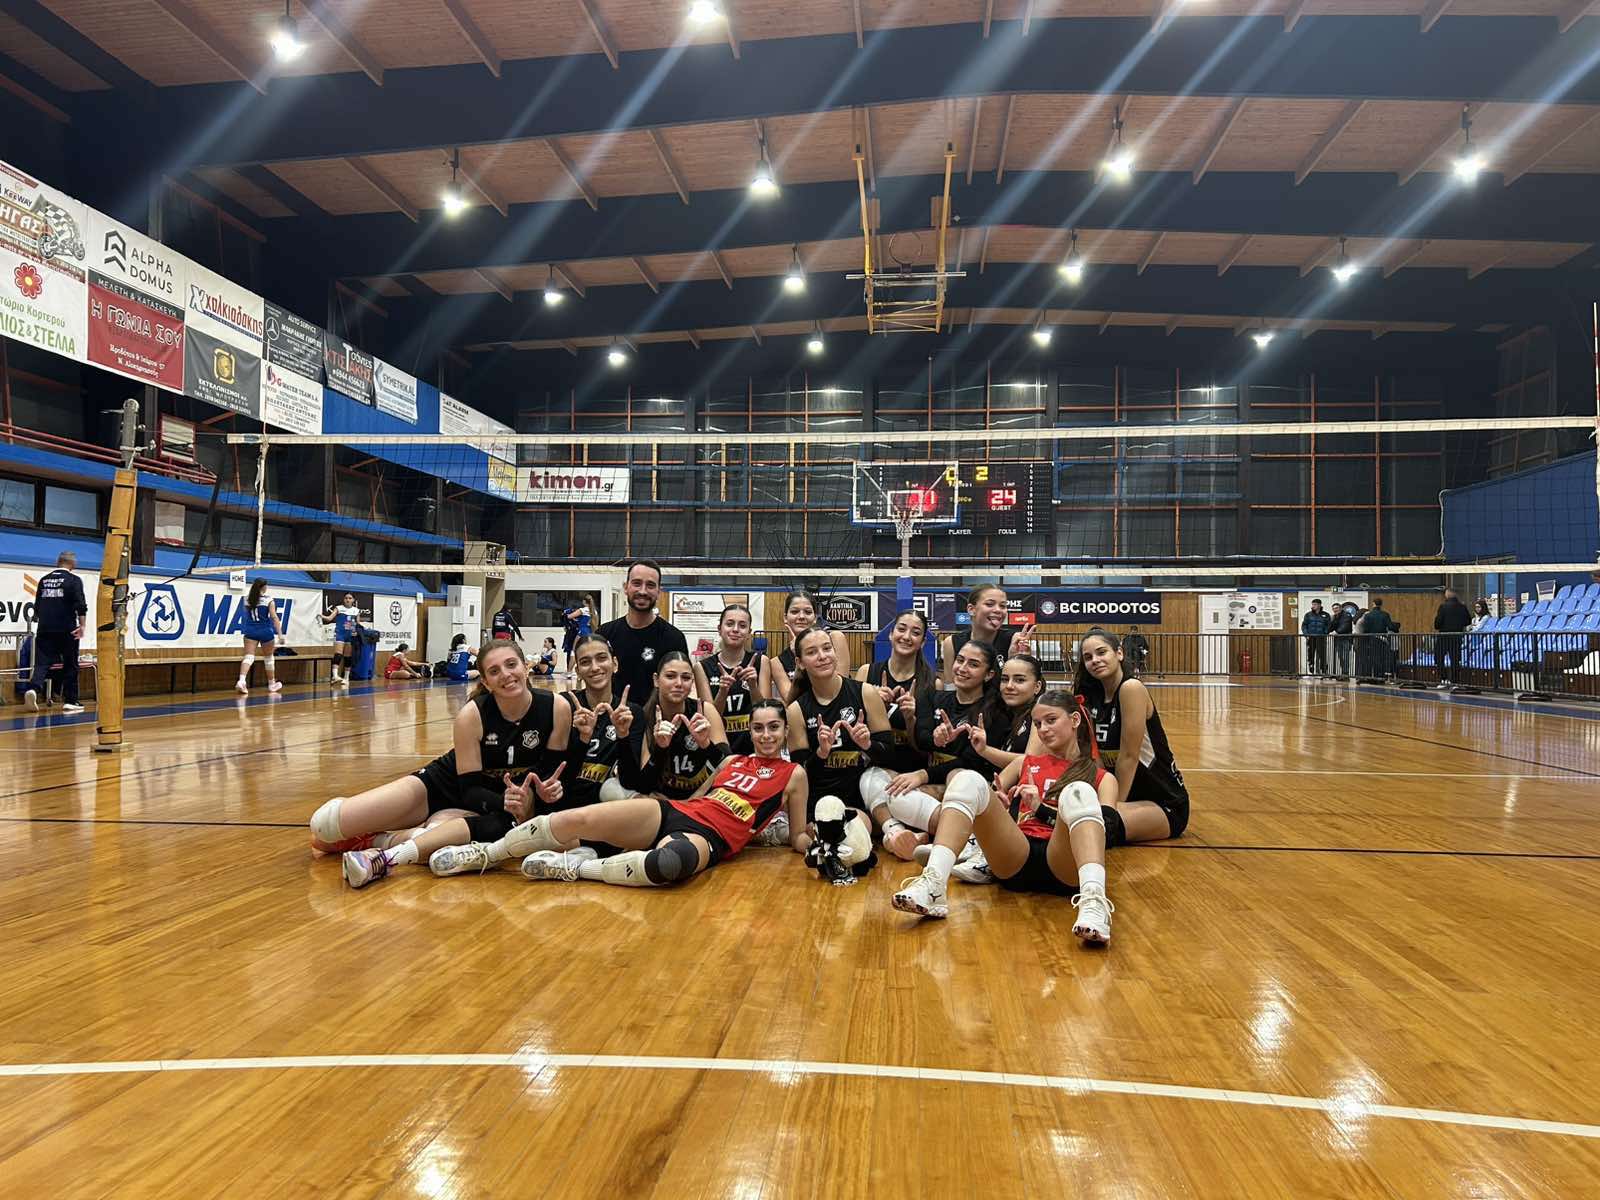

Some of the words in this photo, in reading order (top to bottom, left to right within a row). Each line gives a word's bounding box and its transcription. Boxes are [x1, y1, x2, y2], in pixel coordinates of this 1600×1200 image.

[131, 247, 173, 277] ALPHA
[129, 265, 173, 294] DOMUS
[91, 298, 103, 319] Η
[107, 304, 152, 338] ΓΩΝΙΑ
[154, 323, 183, 349] ΣΟΥ
[33, 324, 76, 355] ΣΤΕΛΛΑ
[975, 466, 989, 481] 2
[991, 489, 1017, 505] 24
[1059, 602, 1080, 614] BC
[1082, 602, 1160, 614] IRODOTOS
[726, 693, 744, 712] 17
[506, 745, 515, 765] 1
[586, 739, 600, 757] 2
[673, 754, 695, 774] 14
[723, 771, 759, 794] 20
